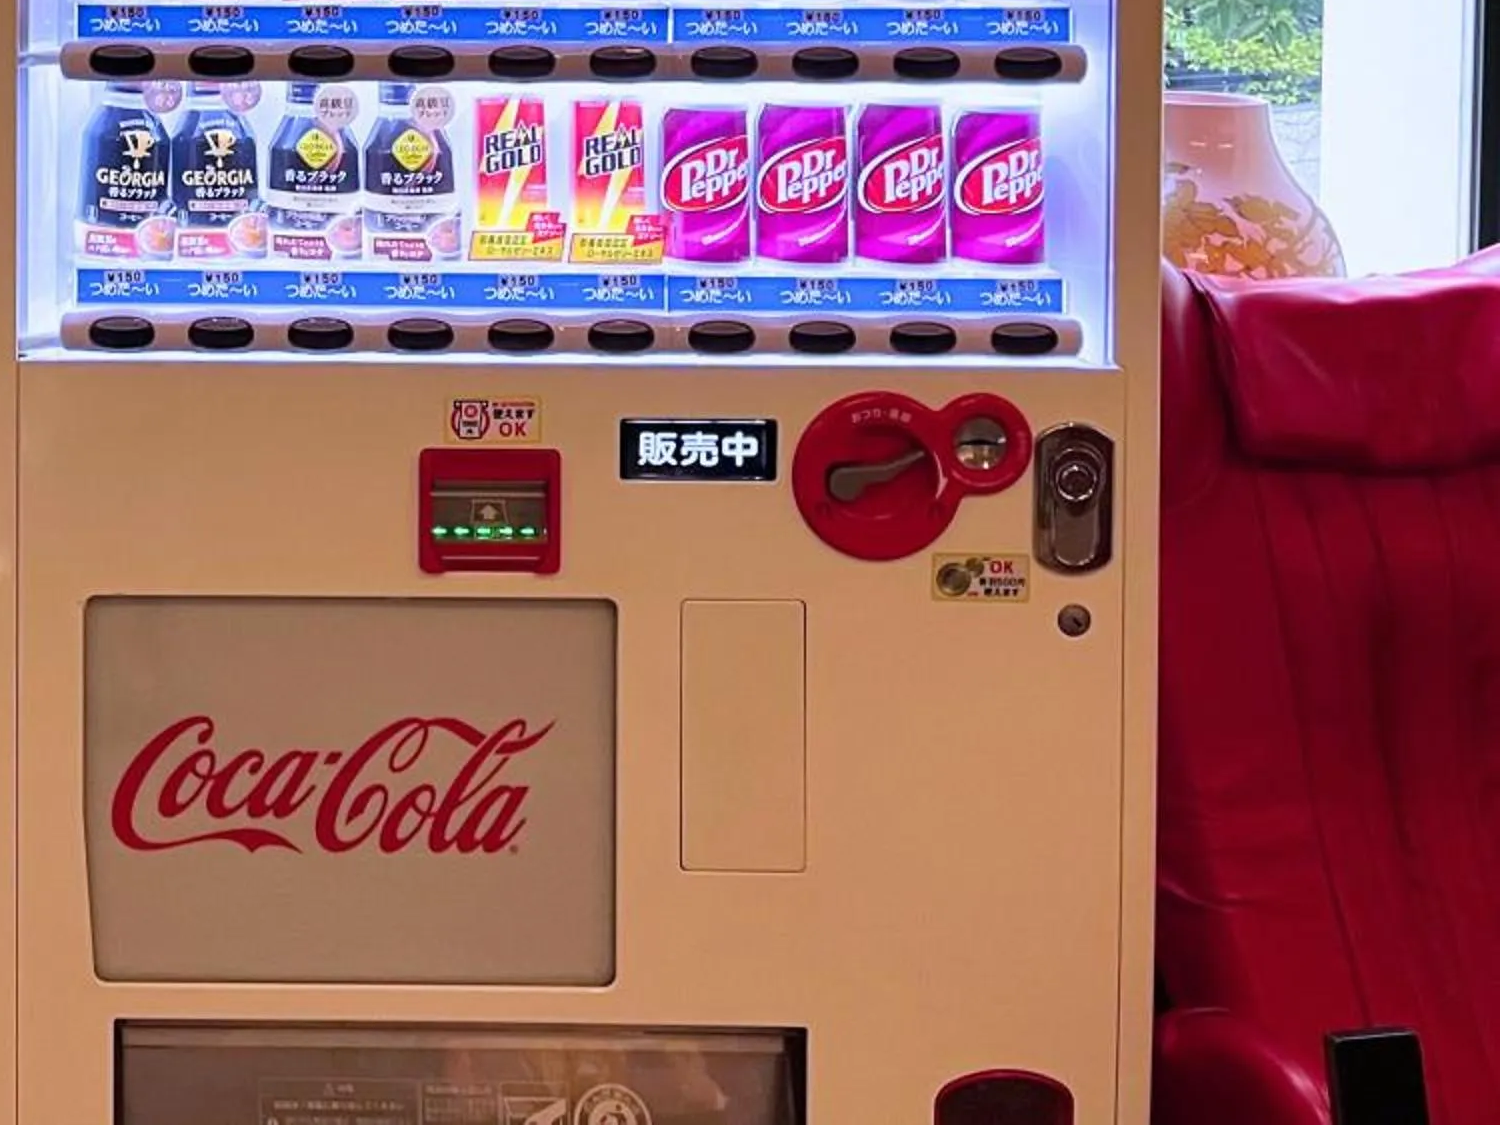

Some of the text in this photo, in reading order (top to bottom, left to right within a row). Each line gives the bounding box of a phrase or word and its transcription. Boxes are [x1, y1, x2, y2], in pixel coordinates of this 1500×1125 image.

[485, 124, 542, 155] REAL
[585, 126, 639, 158] REAL
[485, 145, 542, 174] GOLD
[585, 146, 641, 176] GOLD
[705, 147, 739, 176] Dr
[802, 149, 837, 178] Dr
[910, 147, 939, 177] Dr
[1008, 149, 1039, 180] Dr
[96, 165, 165, 186] GEORGIA
[182, 166, 254, 186] GEORGIA
[285, 169, 347, 184] 香るブラック
[380, 171, 443, 185] 香るブラック
[499, 422, 527, 437] OK
[637, 431, 759, 467] 販売中
[989, 560, 1014, 574] OK
[110, 714, 559, 855] Coca-Cola
